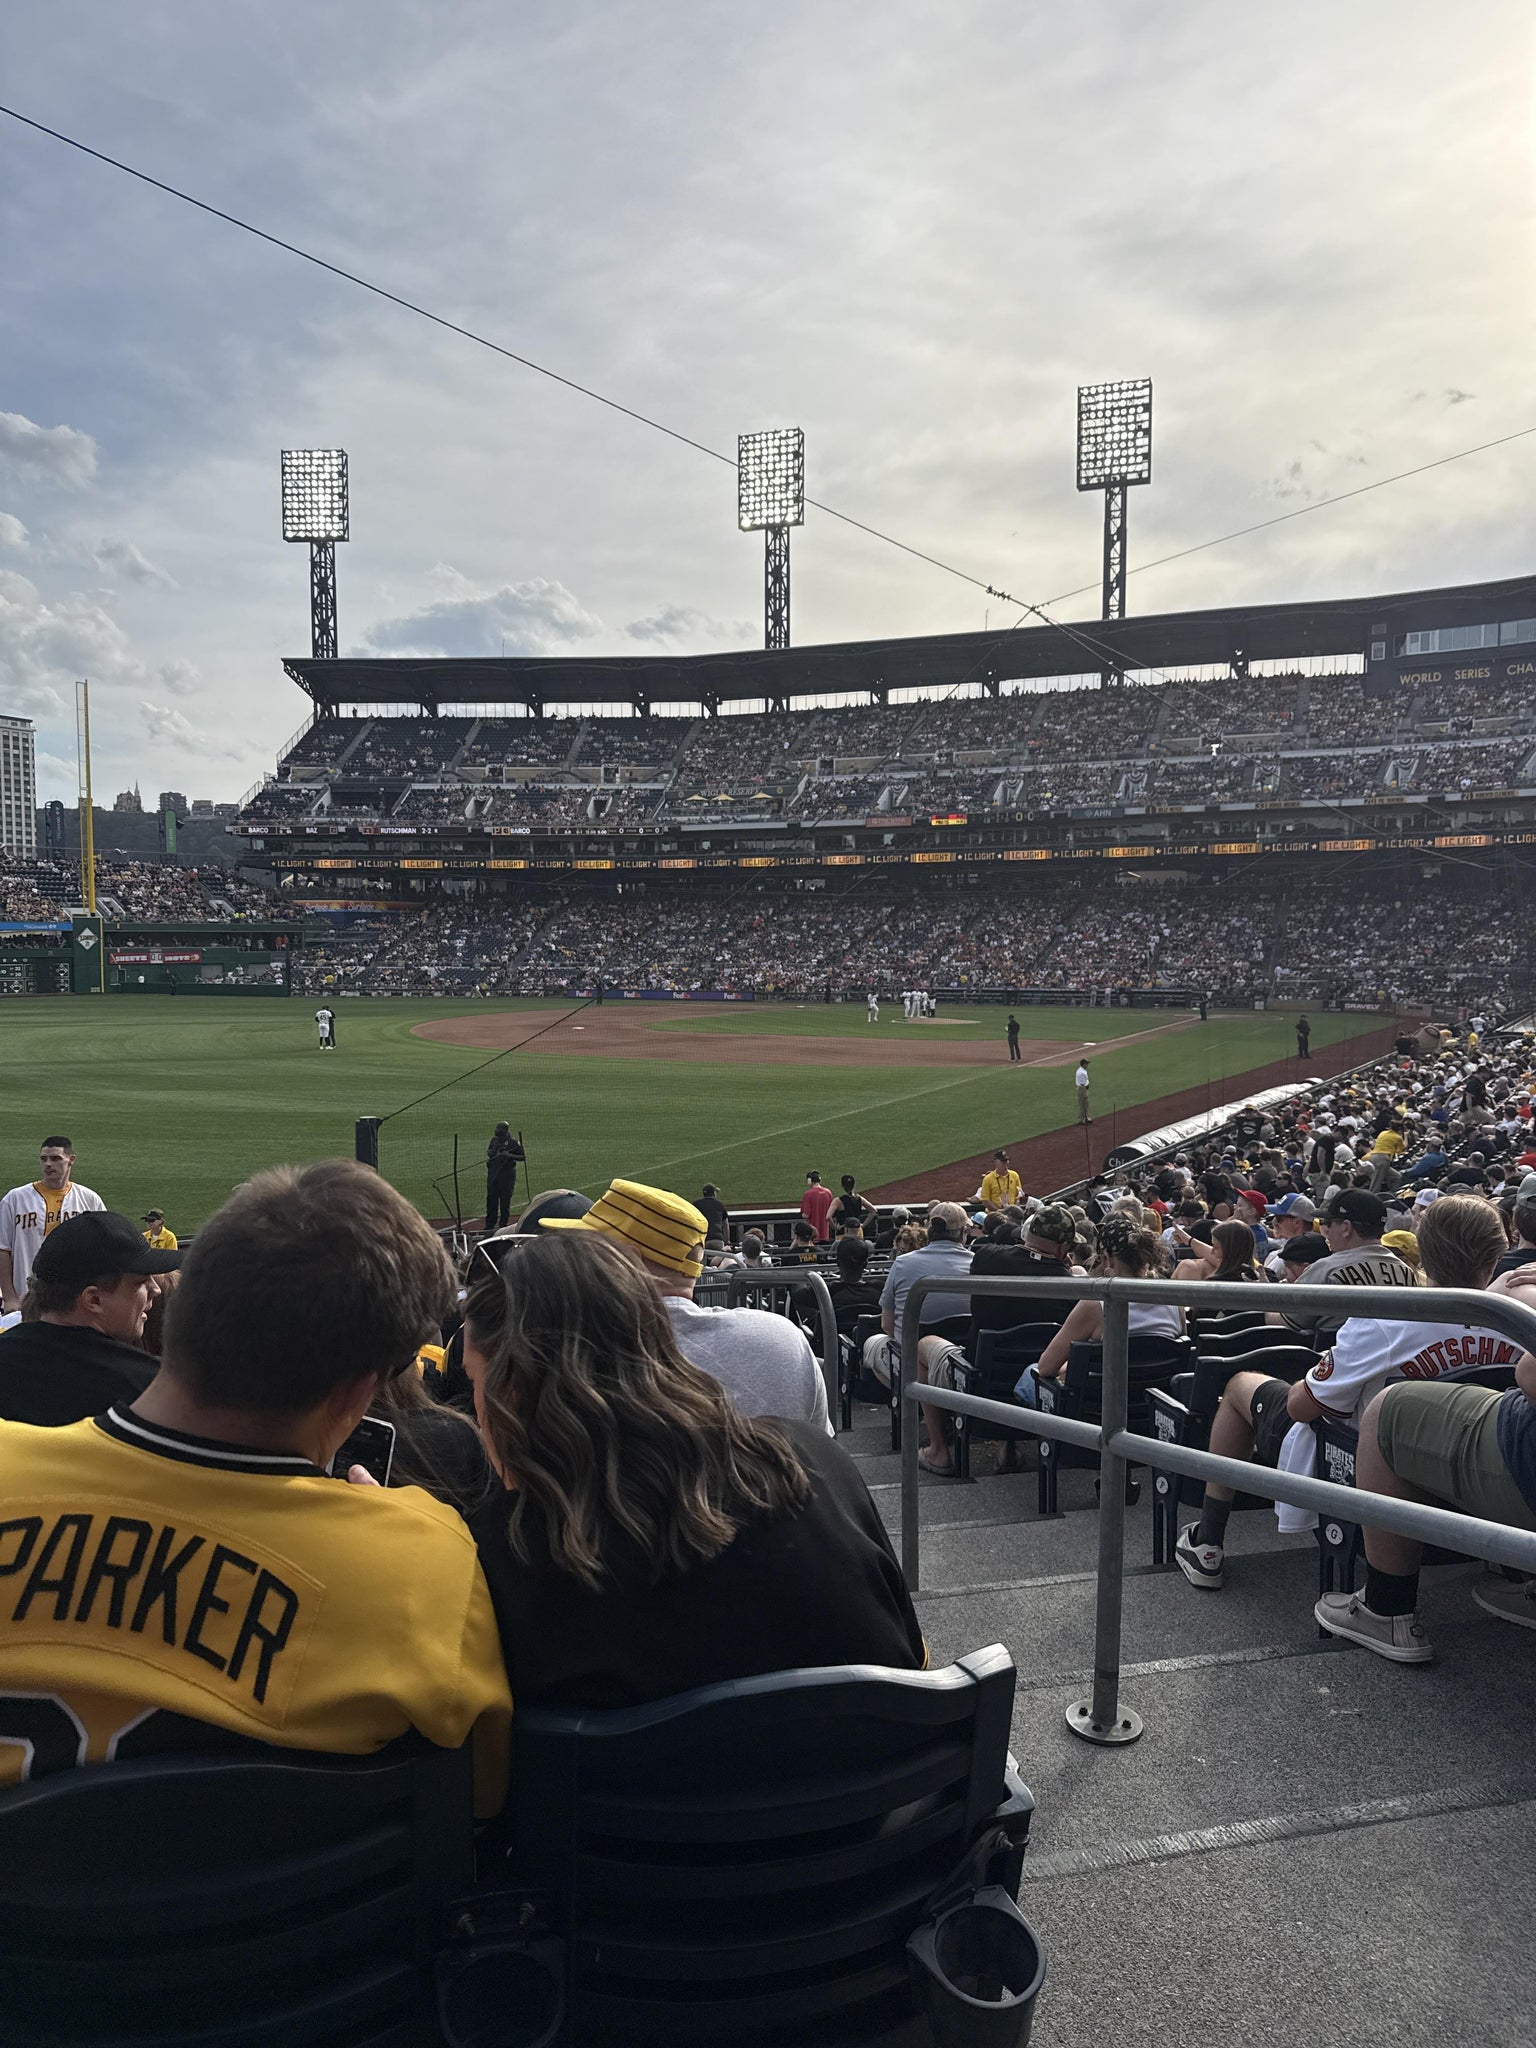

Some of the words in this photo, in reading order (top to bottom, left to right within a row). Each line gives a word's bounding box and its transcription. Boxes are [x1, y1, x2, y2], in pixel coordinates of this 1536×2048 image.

[1400, 672, 1441, 684] WORLD
[1455, 667, 1490, 681] SERIES
[1507, 663, 1536, 675] CHA
[1094, 809, 1111, 817] AHN
[1398, 839, 1424, 847] LIGHT
[1454, 836, 1483, 845] LIGHT
[1175, 846, 1198, 854] LIGHT
[1229, 844, 1253, 852] LIGHT
[1284, 842, 1310, 850] LIGHT
[673, 991, 691, 999] FedEx
[724, 992, 741, 1000] FedEx
[1332, 1261, 1377, 1285] VAN
[1400, 1335, 1518, 1379] RUTSCHM
[1325, 1441, 1355, 1476] PIRATES
